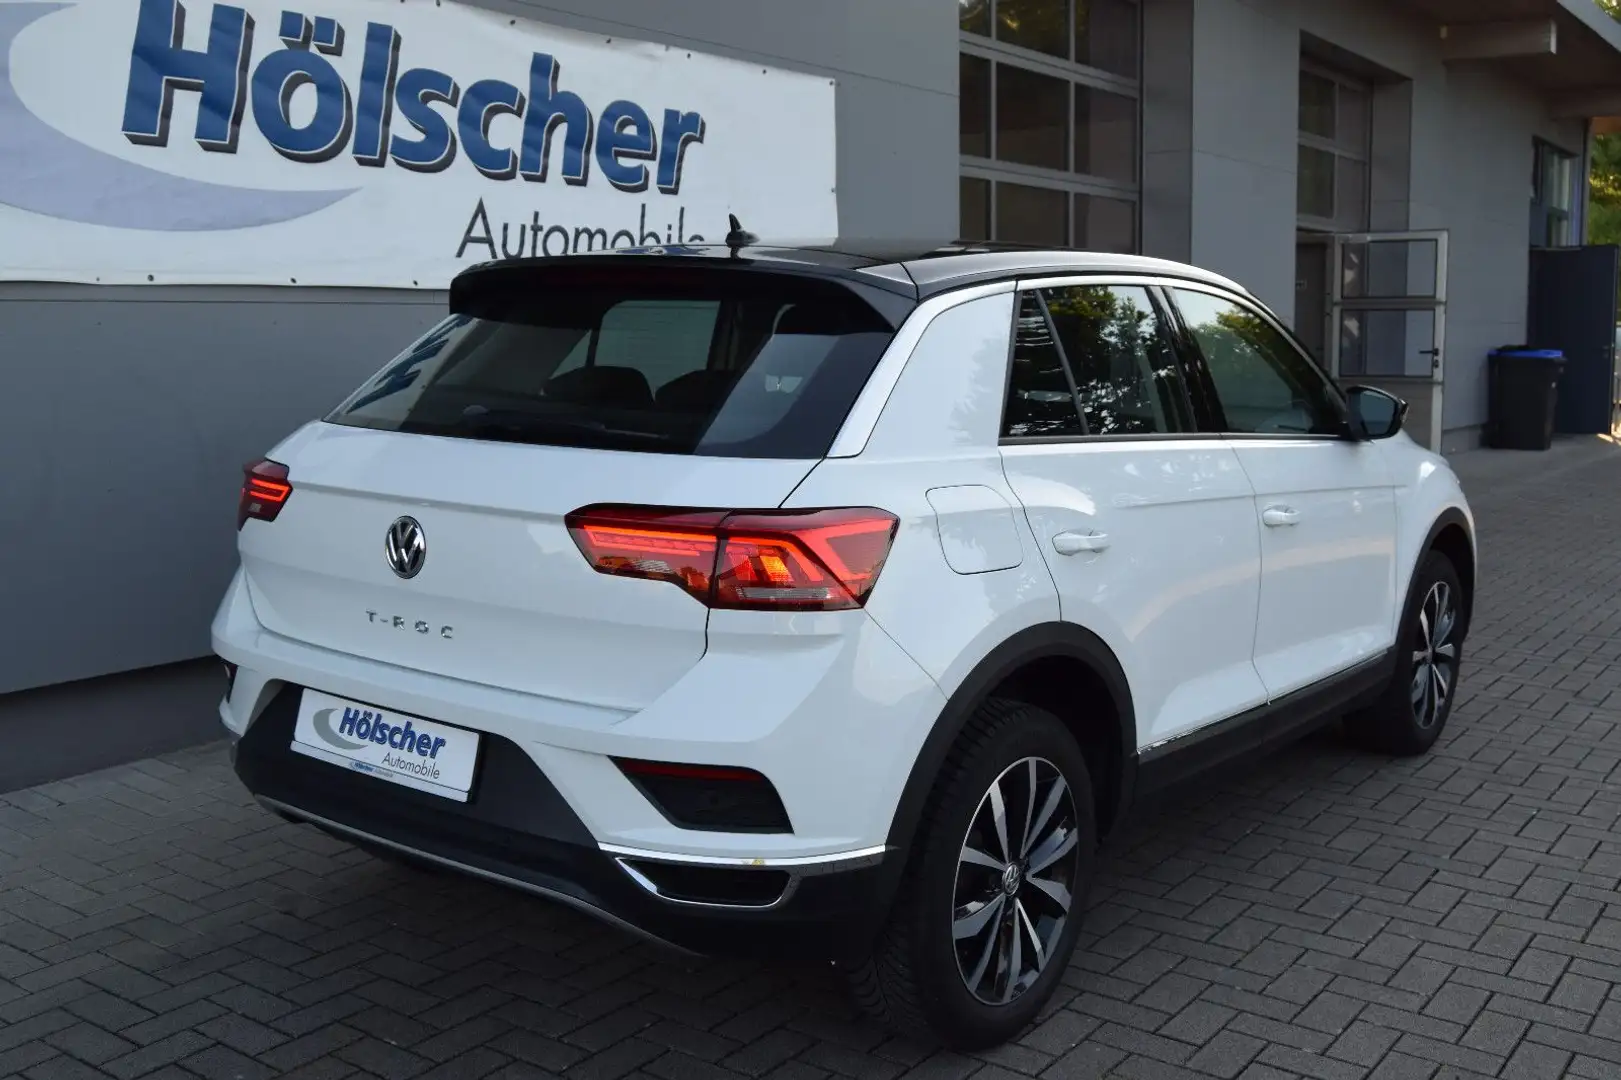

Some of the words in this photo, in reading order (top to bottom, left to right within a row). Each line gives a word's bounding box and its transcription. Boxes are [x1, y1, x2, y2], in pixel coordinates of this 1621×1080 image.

[122, 0, 706, 195] Hölscher
[366, 609, 453, 639] T-ROC
[338, 706, 446, 759] Hölscher
[382, 752, 440, 779] Automobile
